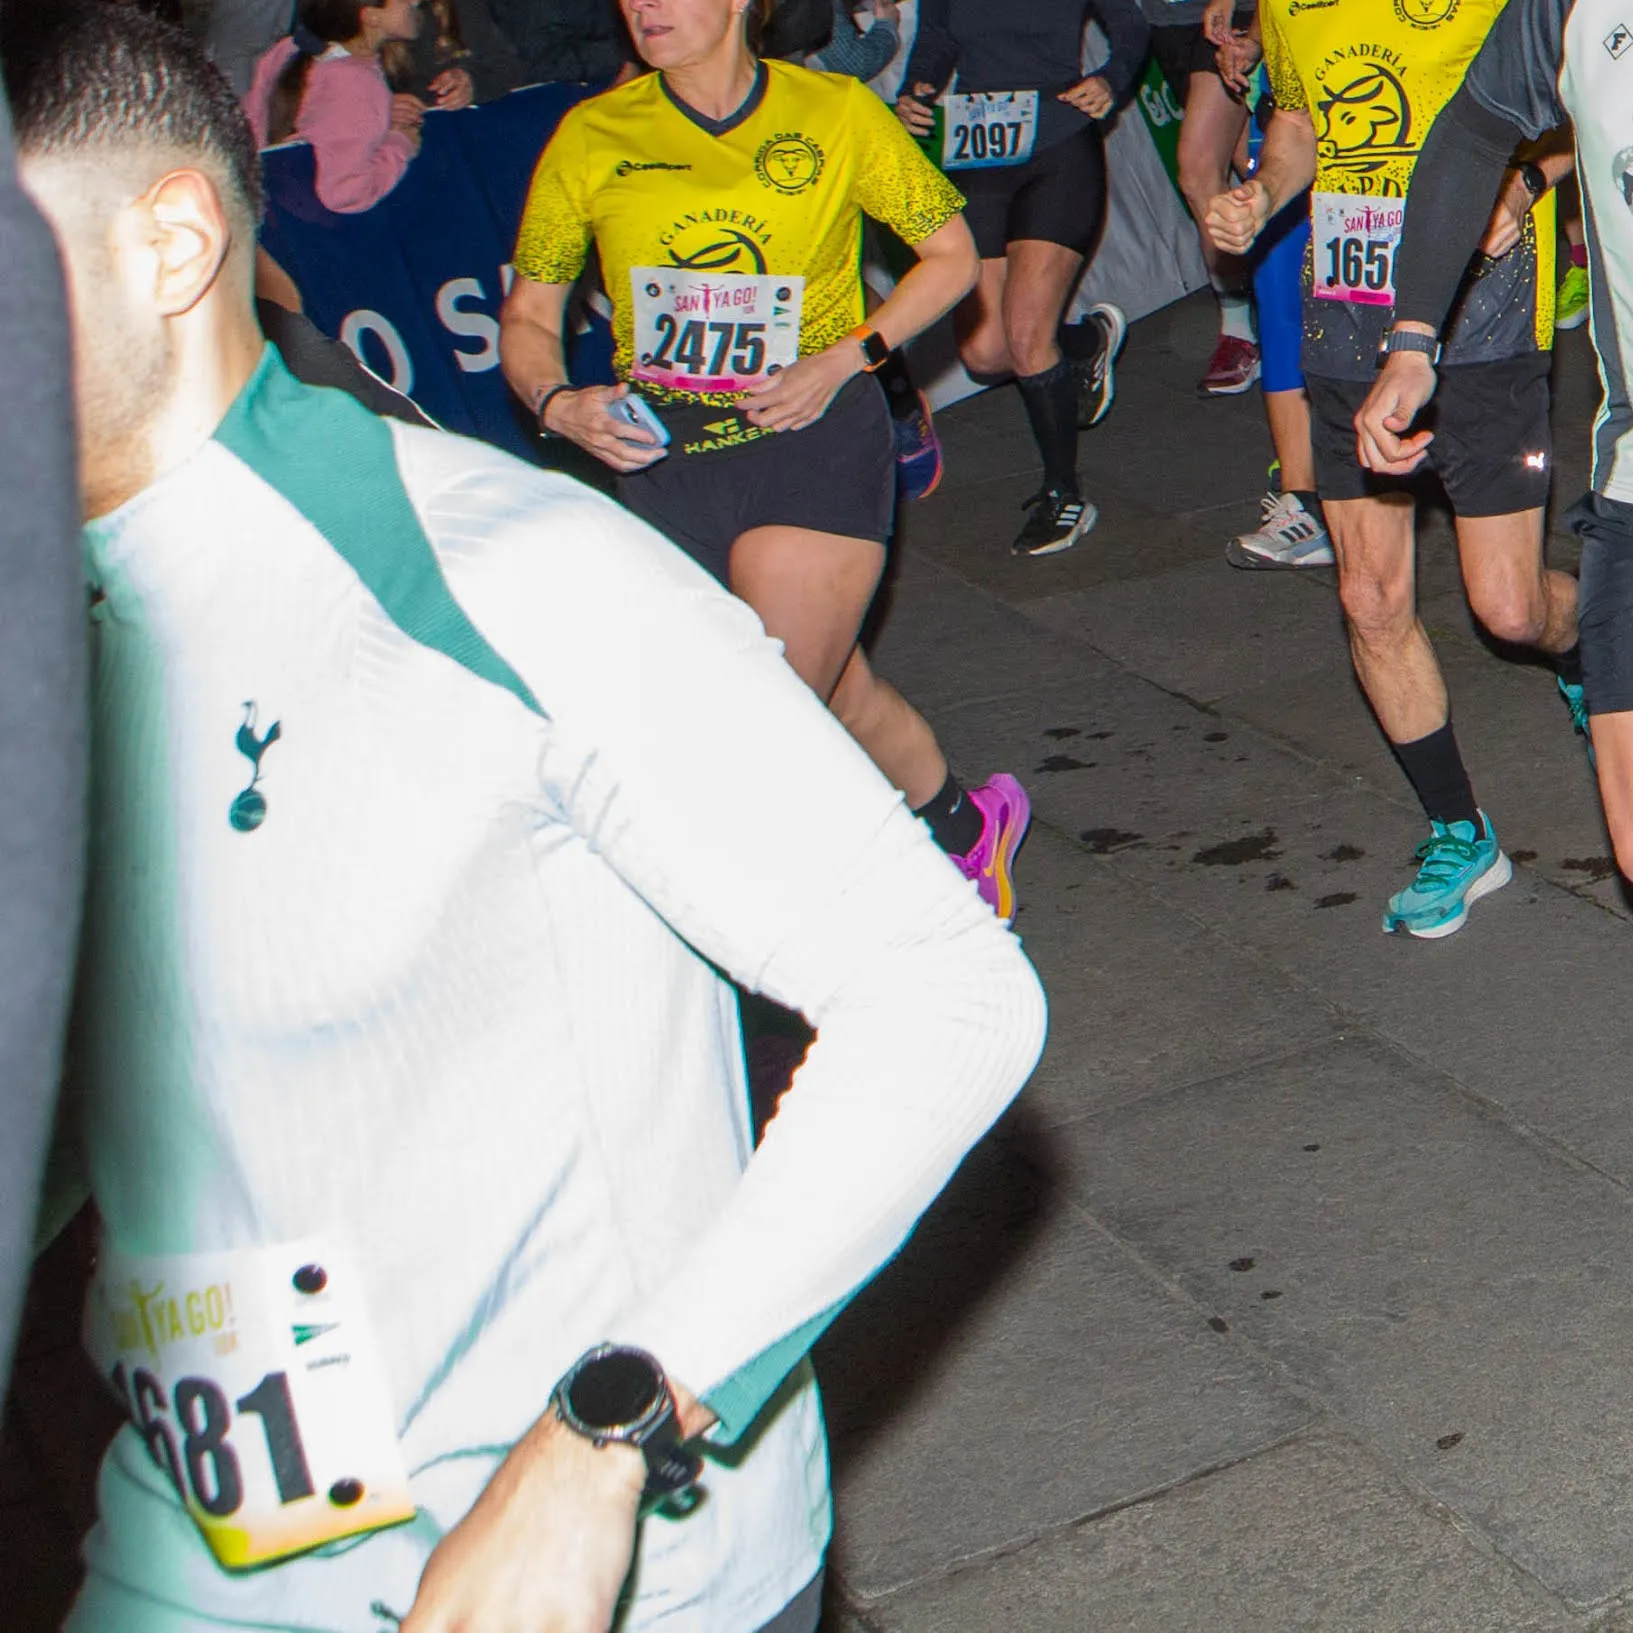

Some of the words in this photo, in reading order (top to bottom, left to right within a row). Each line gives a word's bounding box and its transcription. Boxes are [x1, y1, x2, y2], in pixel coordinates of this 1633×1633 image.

[1314, 42, 1408, 84] GANADERÍA
[953, 120, 1023, 161] 2097
[659, 208, 773, 246] GANADERÍA
[1325, 234, 1398, 292] 165
[651, 313, 768, 377] 2475
